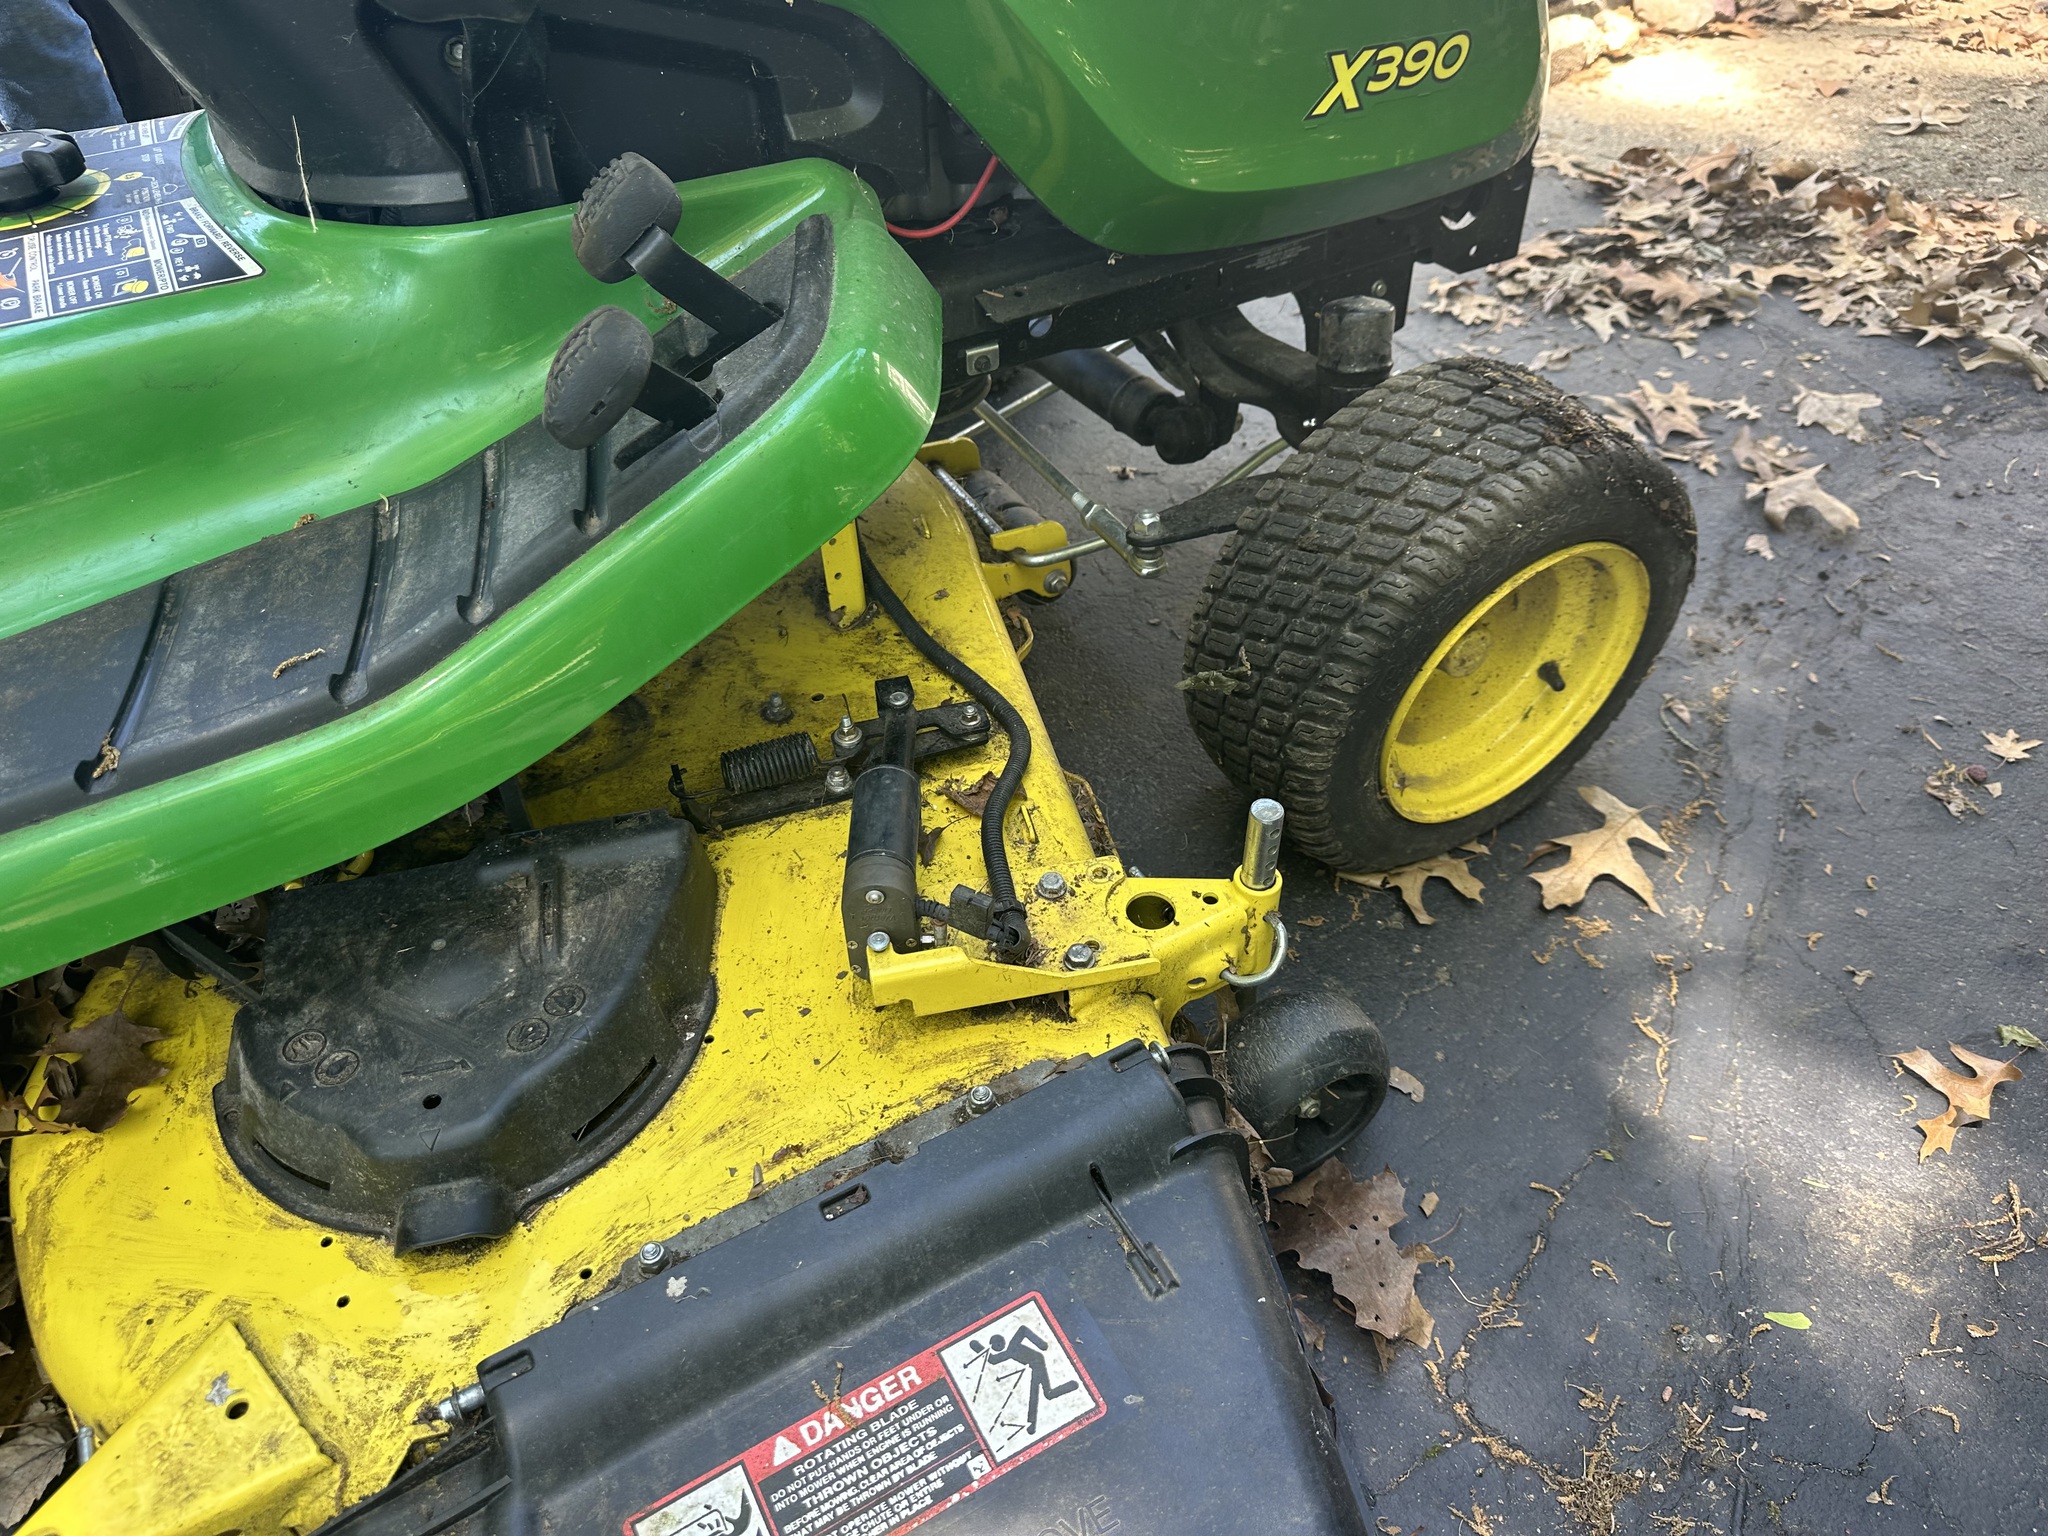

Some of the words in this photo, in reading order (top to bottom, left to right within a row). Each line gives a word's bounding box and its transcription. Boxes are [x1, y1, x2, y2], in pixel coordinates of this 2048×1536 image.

[1306, 32, 1471, 118] X390
[31, 279, 41, 294] PARK
[221, 240, 245, 261] REVERSE
[32, 295, 44, 314] BRAKE
[68, 295, 77, 304] OFF
[793, 1428, 867, 1476] ROTATING
[869, 1399, 918, 1432] BLADE
[799, 1366, 921, 1445] DANGER
[770, 1488, 786, 1502] DO
[786, 1475, 806, 1493] NOT
[807, 1463, 826, 1480] PUT
[828, 1445, 861, 1468] HANDS
[861, 1436, 877, 1449] OR
[876, 1422, 900, 1440] FEET
[901, 1403, 934, 1426] UNDER
[934, 1394, 949, 1407] OR
[774, 1493, 798, 1511] INTO
[798, 1471, 836, 1497] MOWER
[835, 1454, 865, 1475] WHEN
[865, 1433, 901, 1458] ENGINE
[901, 1427, 911, 1438] IS
[911, 1403, 954, 1431] RUNNING
[802, 1465, 868, 1507] THROWN
[870, 1426, 937, 1469] OBJECTS
[783, 1507, 821, 1533] BEFORE
[858, 1467, 889, 1489] CLEAR
[889, 1454, 914, 1472] AREA
[912, 1445, 925, 1458] OF
[813, 1510, 834, 1528] MAY
[835, 1502, 850, 1516] BE
[849, 1477, 891, 1506] THROWN
[890, 1468, 904, 1483] BY
[905, 1450, 937, 1474] BLADE
[839, 1501, 887, 1533] OPERATE
[888, 1478, 927, 1504] MOWER
[927, 1450, 971, 1481] WITHOUT
[860, 1508, 893, 1532] CHUTE
[893, 1499, 909, 1512] OR
[909, 1477, 944, 1502] ENTIRE
[888, 1514, 900, 1526] IN
[899, 1494, 933, 1519] PLACE
